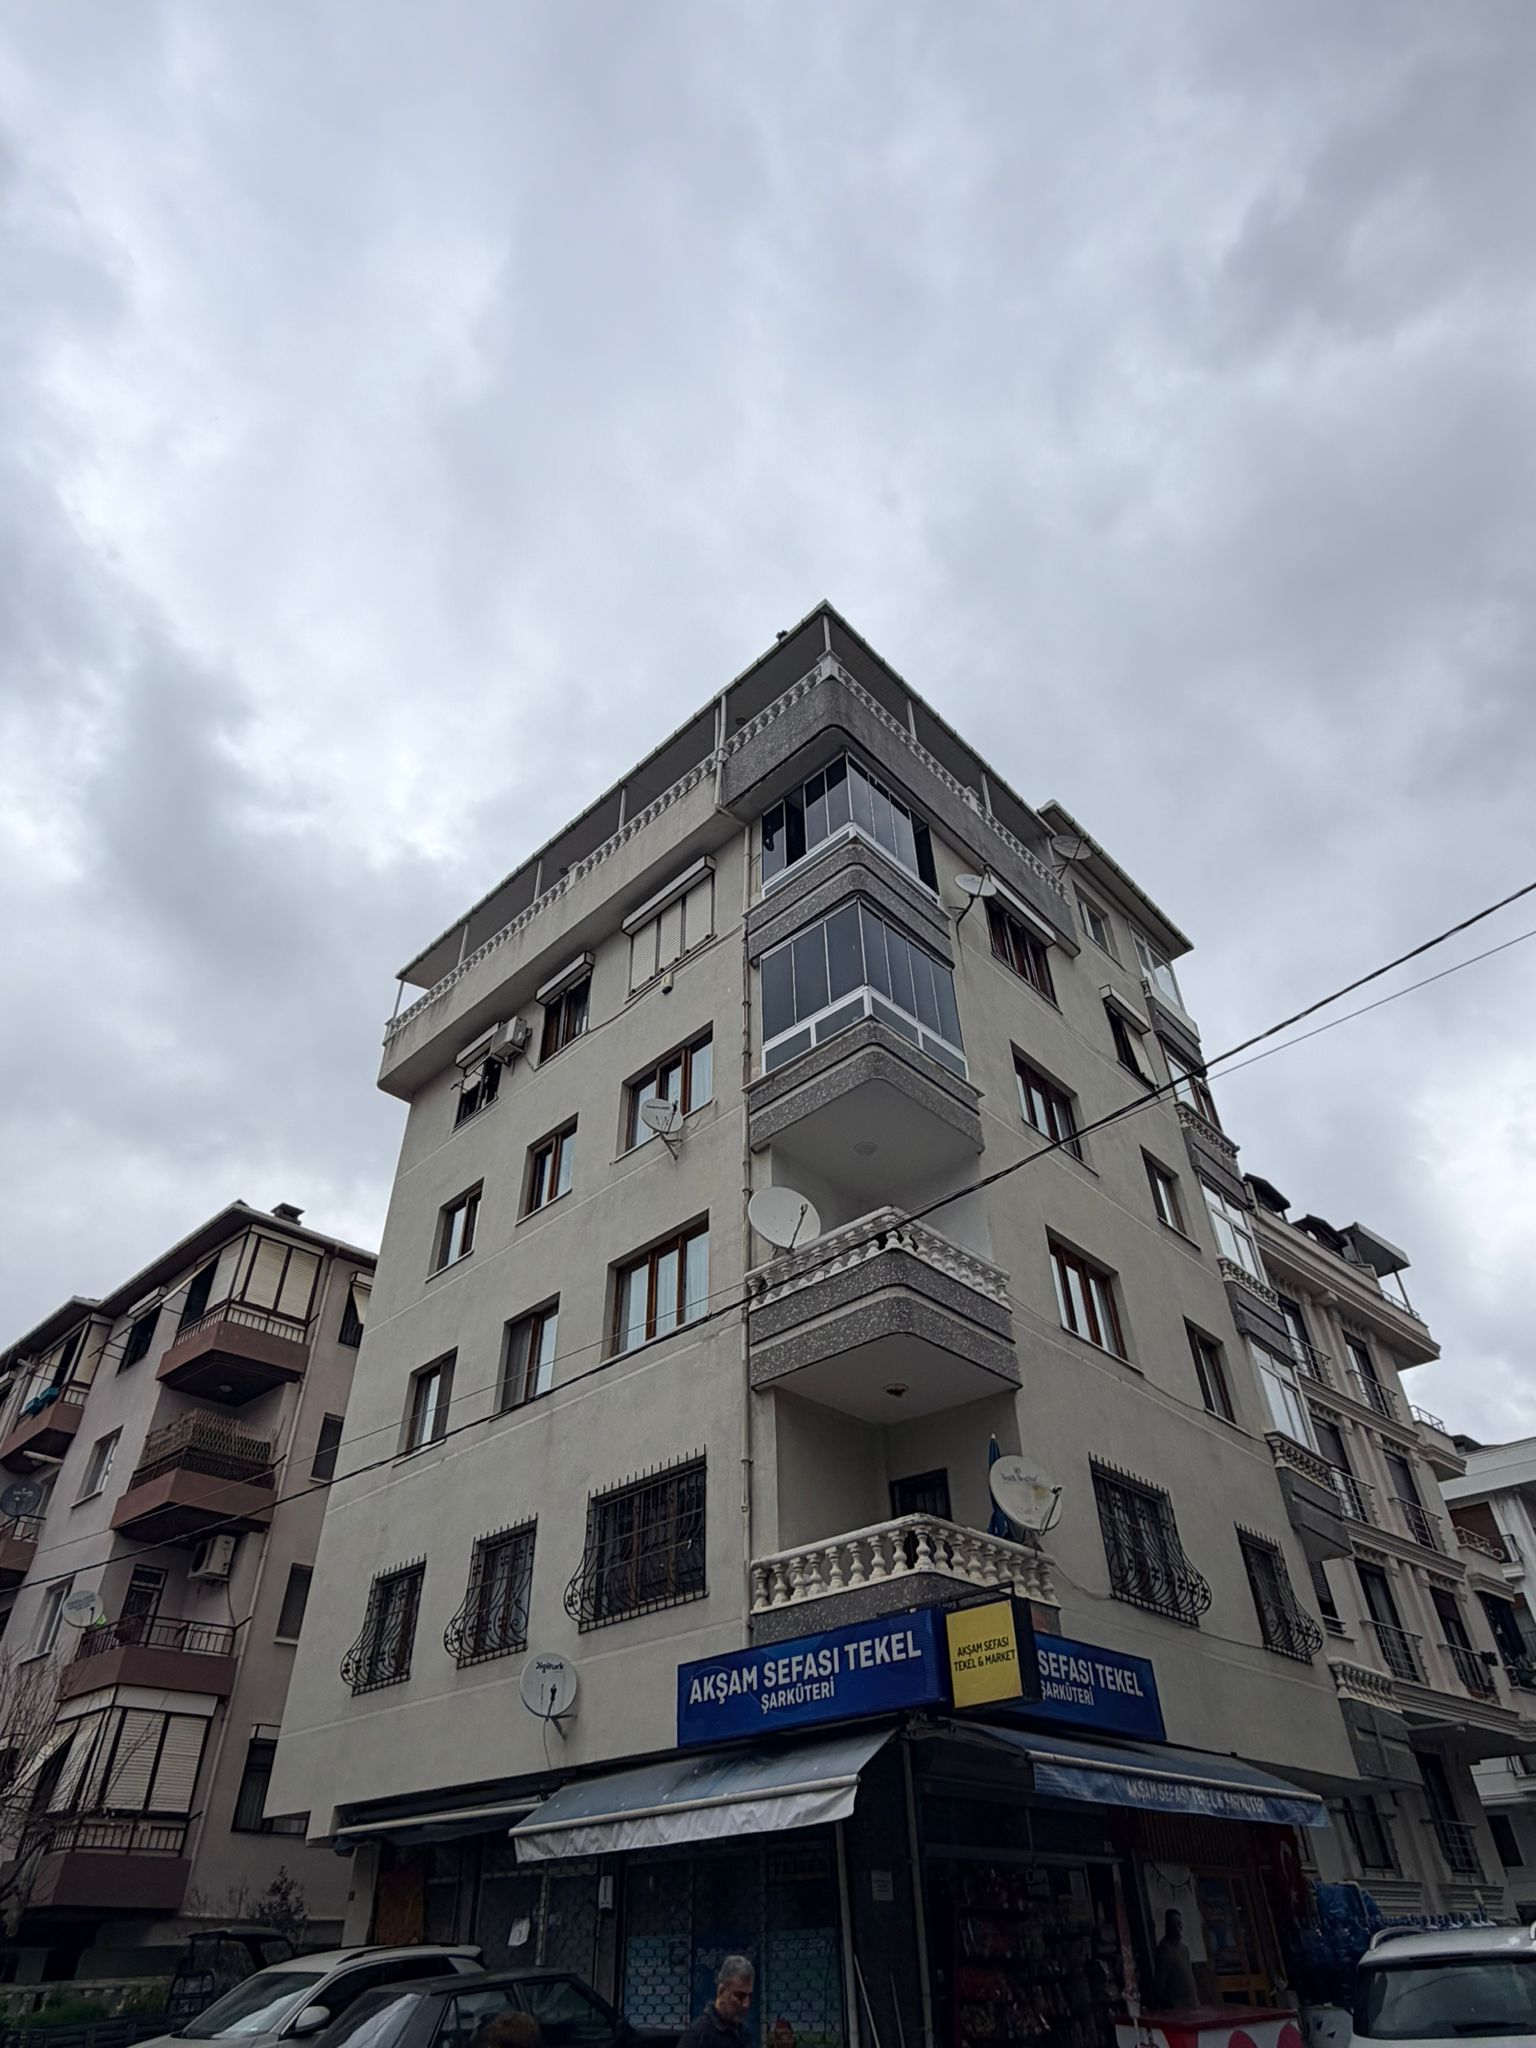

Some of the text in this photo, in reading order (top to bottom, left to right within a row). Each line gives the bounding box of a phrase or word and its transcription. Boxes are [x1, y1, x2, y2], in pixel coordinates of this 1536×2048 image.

[954, 1649, 1015, 1672] TEKEL & MARKET
[957, 1636, 1009, 1657] AKŞAM SEFASI
[689, 1630, 922, 1705] AKŞAM SEFASI TEKEL
[1037, 1649, 1144, 1697] SEFASI TEKEL
[761, 1675, 835, 1714] ŞARKÜTERİ
[1040, 1680, 1094, 1706] ŞARKÜTERİ
